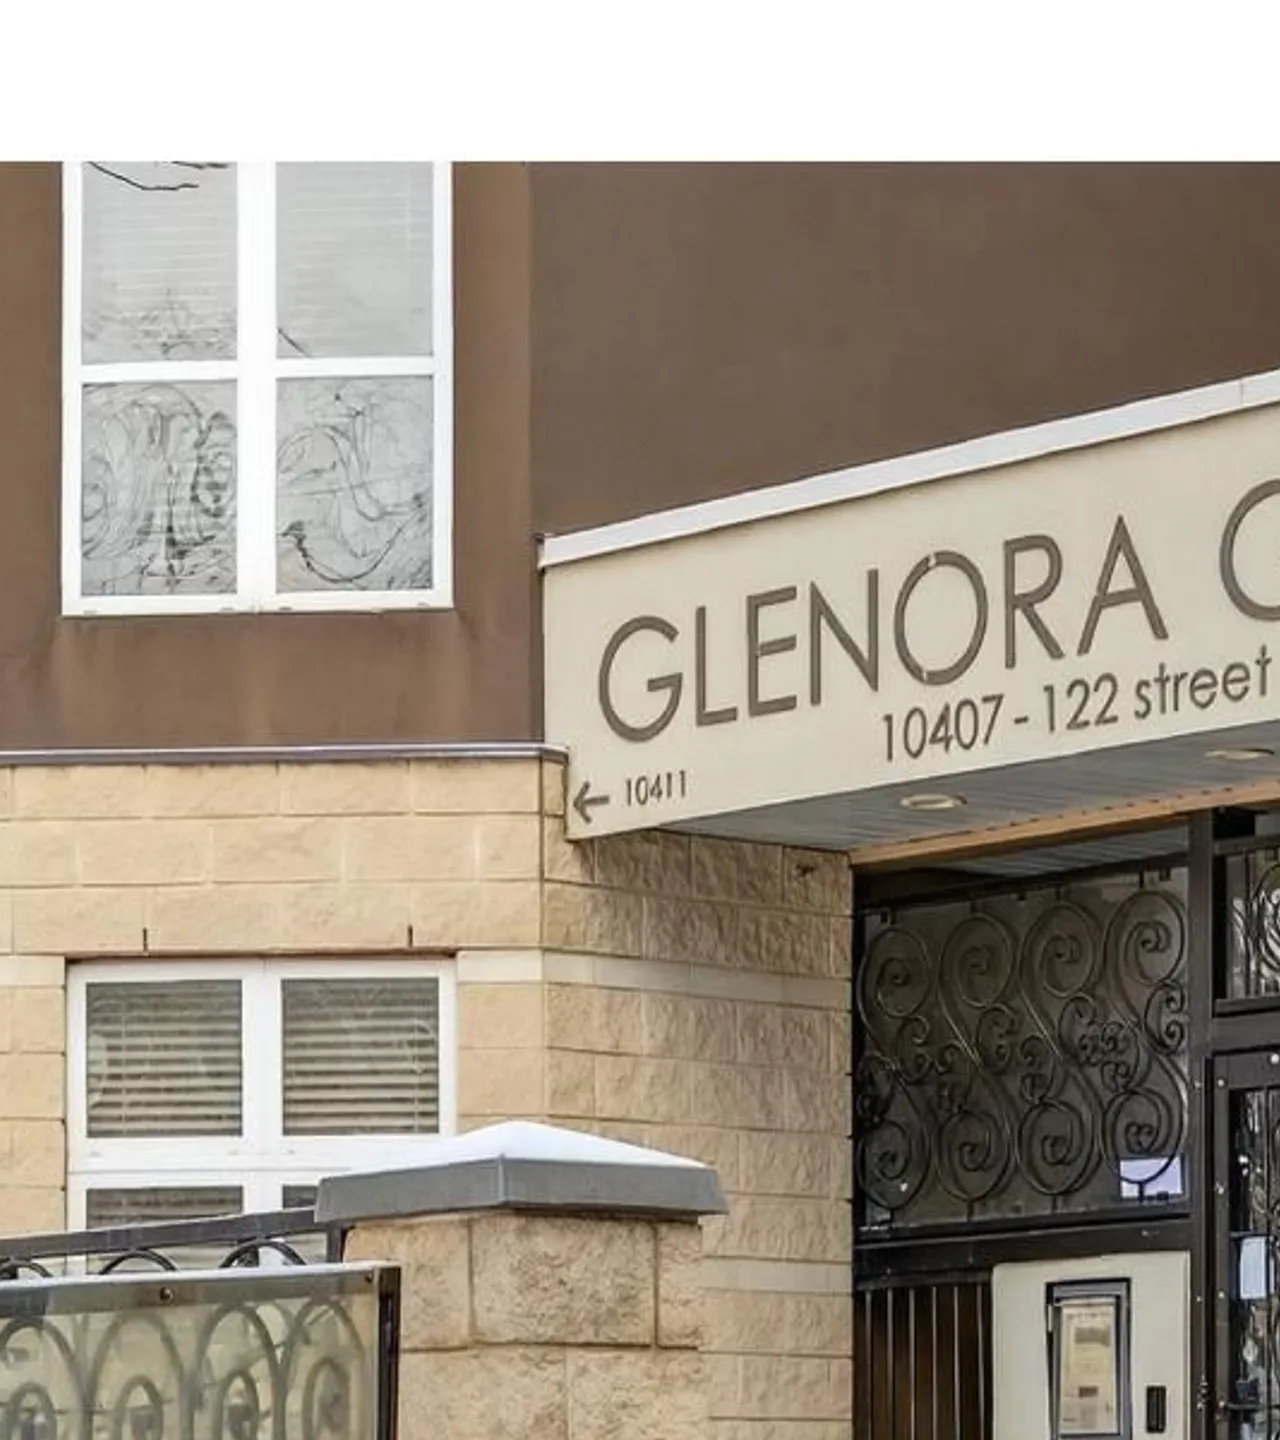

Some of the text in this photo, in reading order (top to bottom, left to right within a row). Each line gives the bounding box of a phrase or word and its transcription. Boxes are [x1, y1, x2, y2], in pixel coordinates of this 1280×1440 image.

[599, 513, 1169, 743] GLENORA
[1134, 644, 1272, 722] street
[625, 769, 687, 807] 10411
